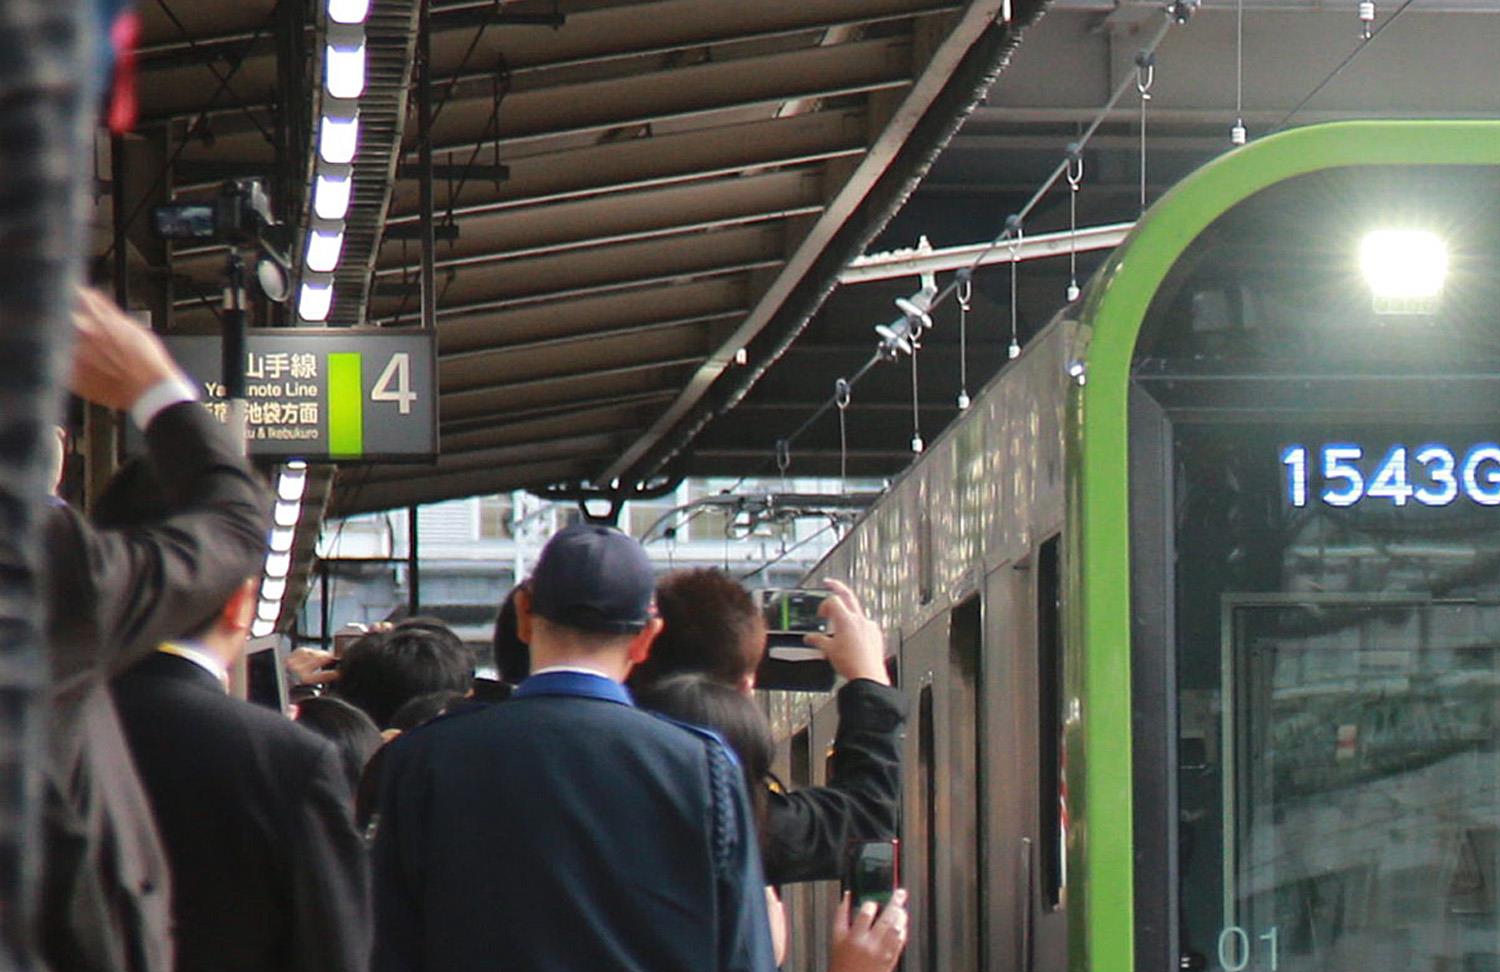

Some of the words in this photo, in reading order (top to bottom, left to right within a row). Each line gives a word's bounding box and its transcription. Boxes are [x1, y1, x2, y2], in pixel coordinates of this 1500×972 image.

[246, 353, 318, 378] 山手線
[371, 352, 417, 414] 4
[205, 382, 282, 397] Yanote
[285, 382, 318, 397] Line
[1218, 926, 1277, 972] 01
